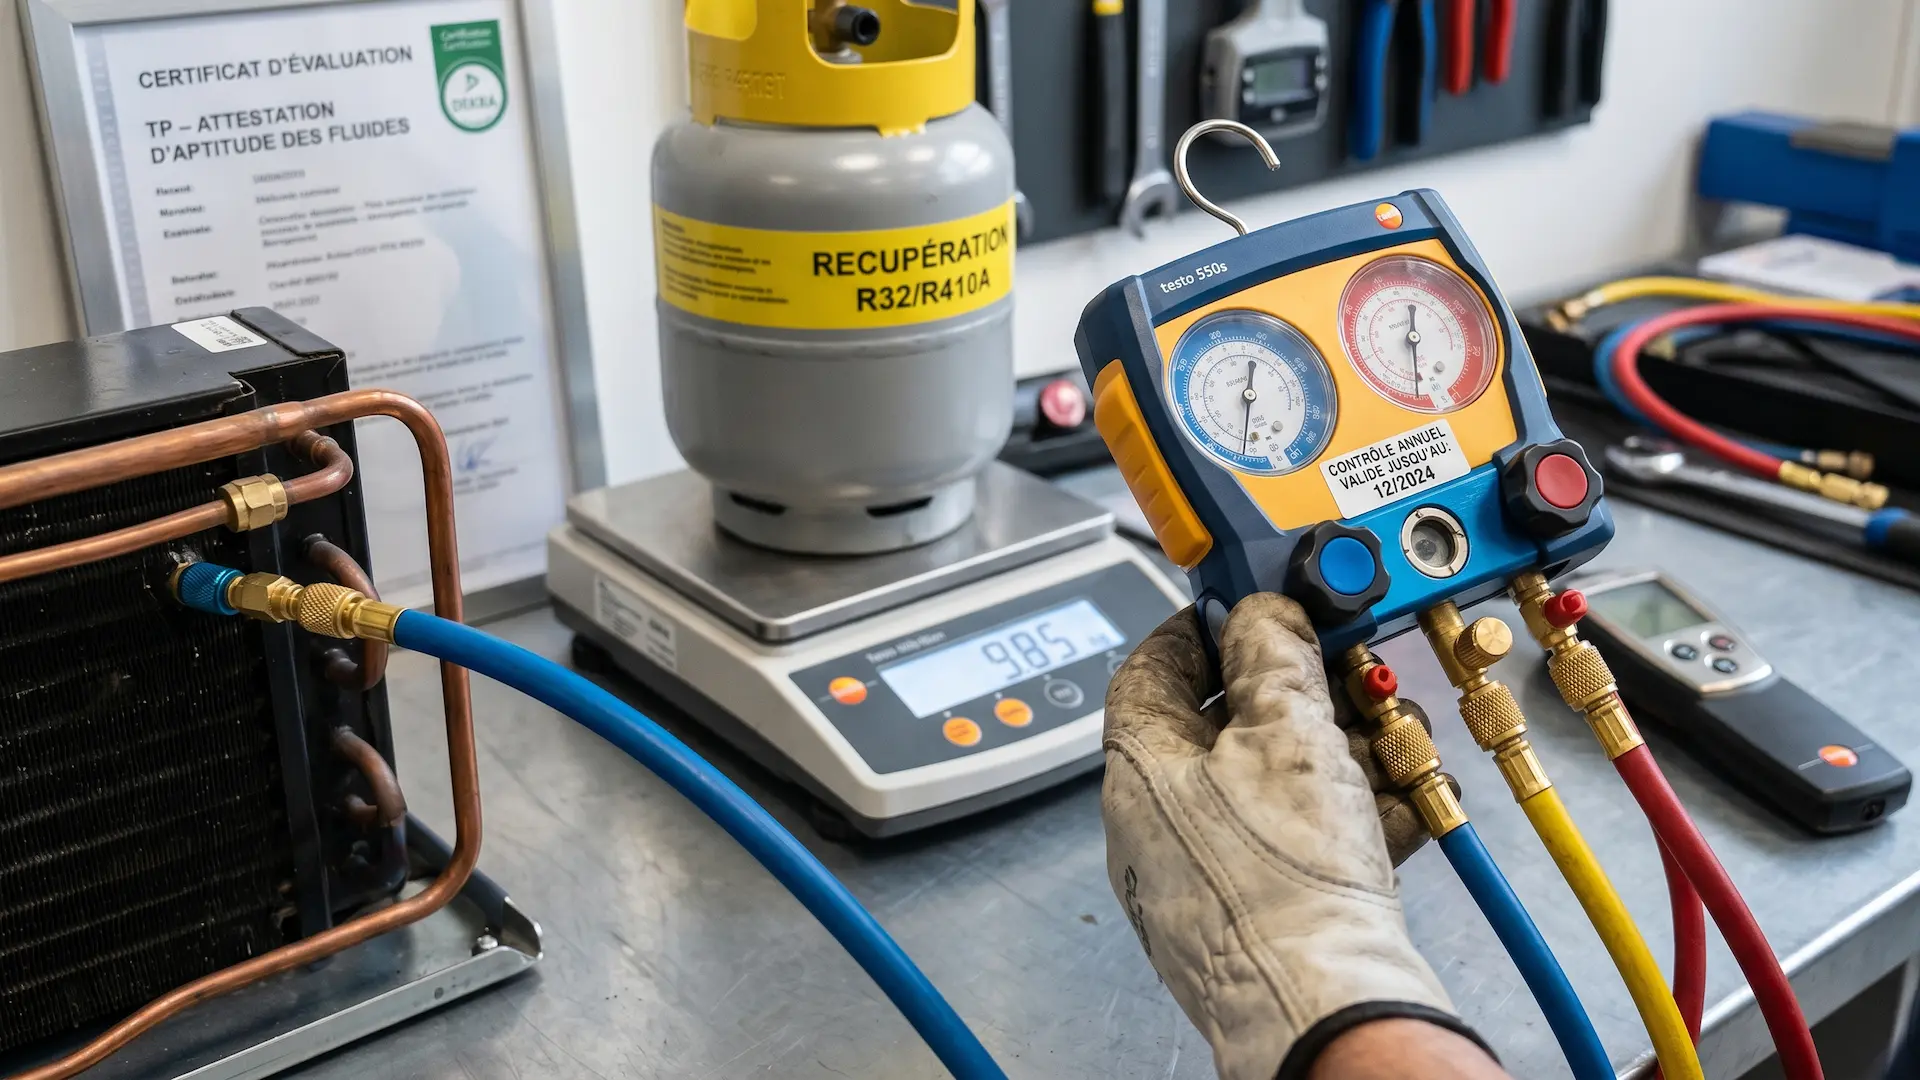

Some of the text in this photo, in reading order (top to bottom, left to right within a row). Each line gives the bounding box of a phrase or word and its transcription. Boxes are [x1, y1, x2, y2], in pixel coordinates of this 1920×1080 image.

[138, 60, 261, 89] CERTIFICAT
[145, 119, 173, 138] TP
[197, 101, 334, 133] ATTESTATION
[281, 128, 323, 149] DES
[328, 117, 411, 144] FLUIDES
[812, 221, 1009, 277] RECUPÉRATION
[857, 267, 991, 313] R32/R410A
[1160, 262, 1228, 293] testo 550s
[1328, 426, 1446, 477] CONTRÔLE ANNUEL
[1339, 464, 1386, 490] VALIDE
[1373, 465, 1436, 499] 12/2024
